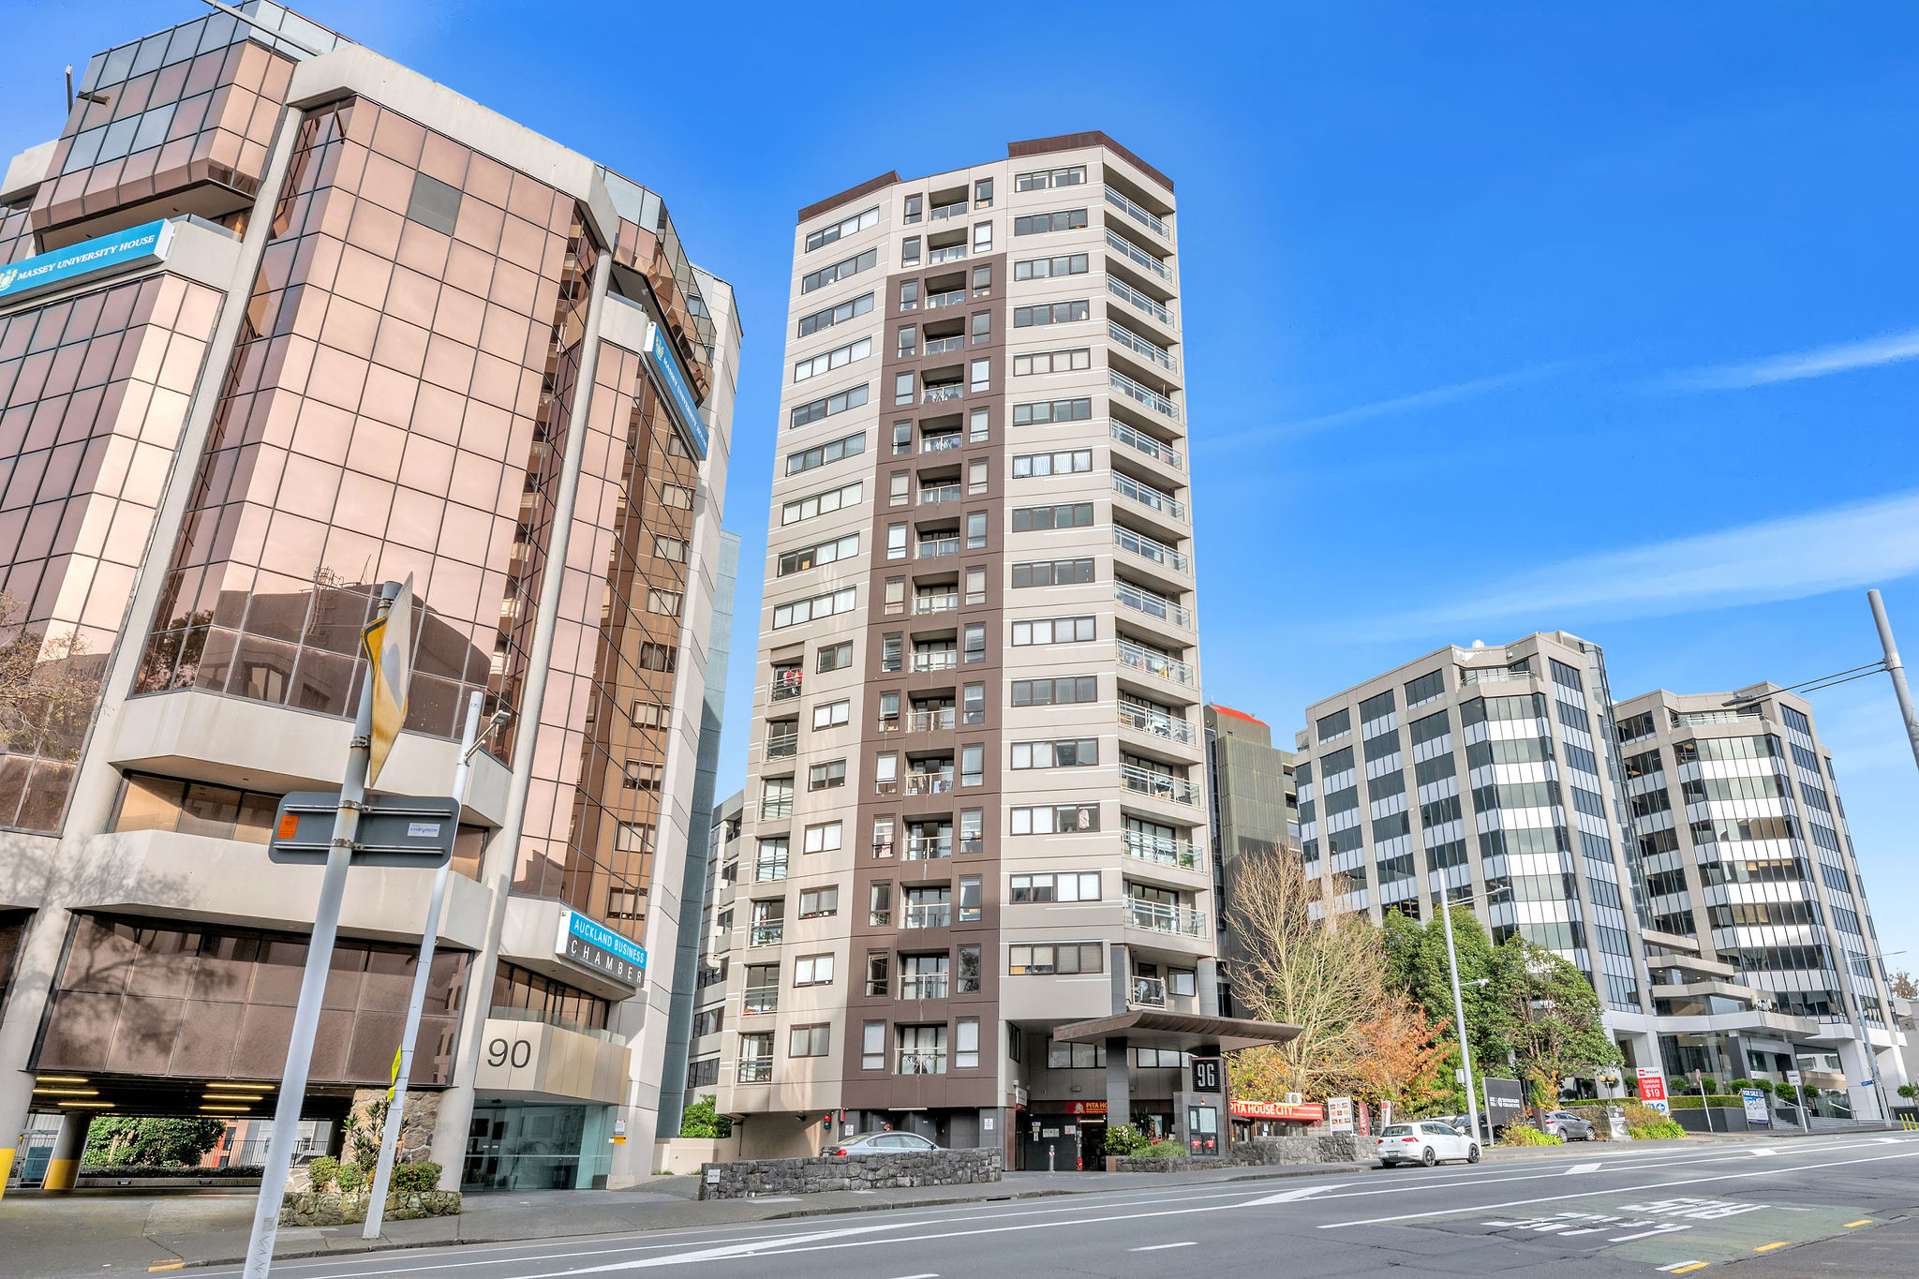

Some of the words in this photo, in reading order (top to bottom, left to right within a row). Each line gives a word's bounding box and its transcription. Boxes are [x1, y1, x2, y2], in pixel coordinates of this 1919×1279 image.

[17, 263, 57, 281] MASSEY
[57, 245, 119, 269] UNIVERSITY
[119, 234, 155, 251] HOUSE
[574, 918, 612, 947] AUCKLAND
[614, 939, 644, 964] BUSINESS
[571, 940, 642, 984] CHAMBER
[487, 1038, 531, 1068] 90
[1197, 1063, 1215, 1087] 96
[1086, 1102, 1099, 1110] PITA
[1645, 1088, 1660, 1098] $19
[1230, 1103, 1247, 1114] PITA
[1248, 1103, 1275, 1115] HOUSE
[1275, 1104, 1293, 1116] CITY
